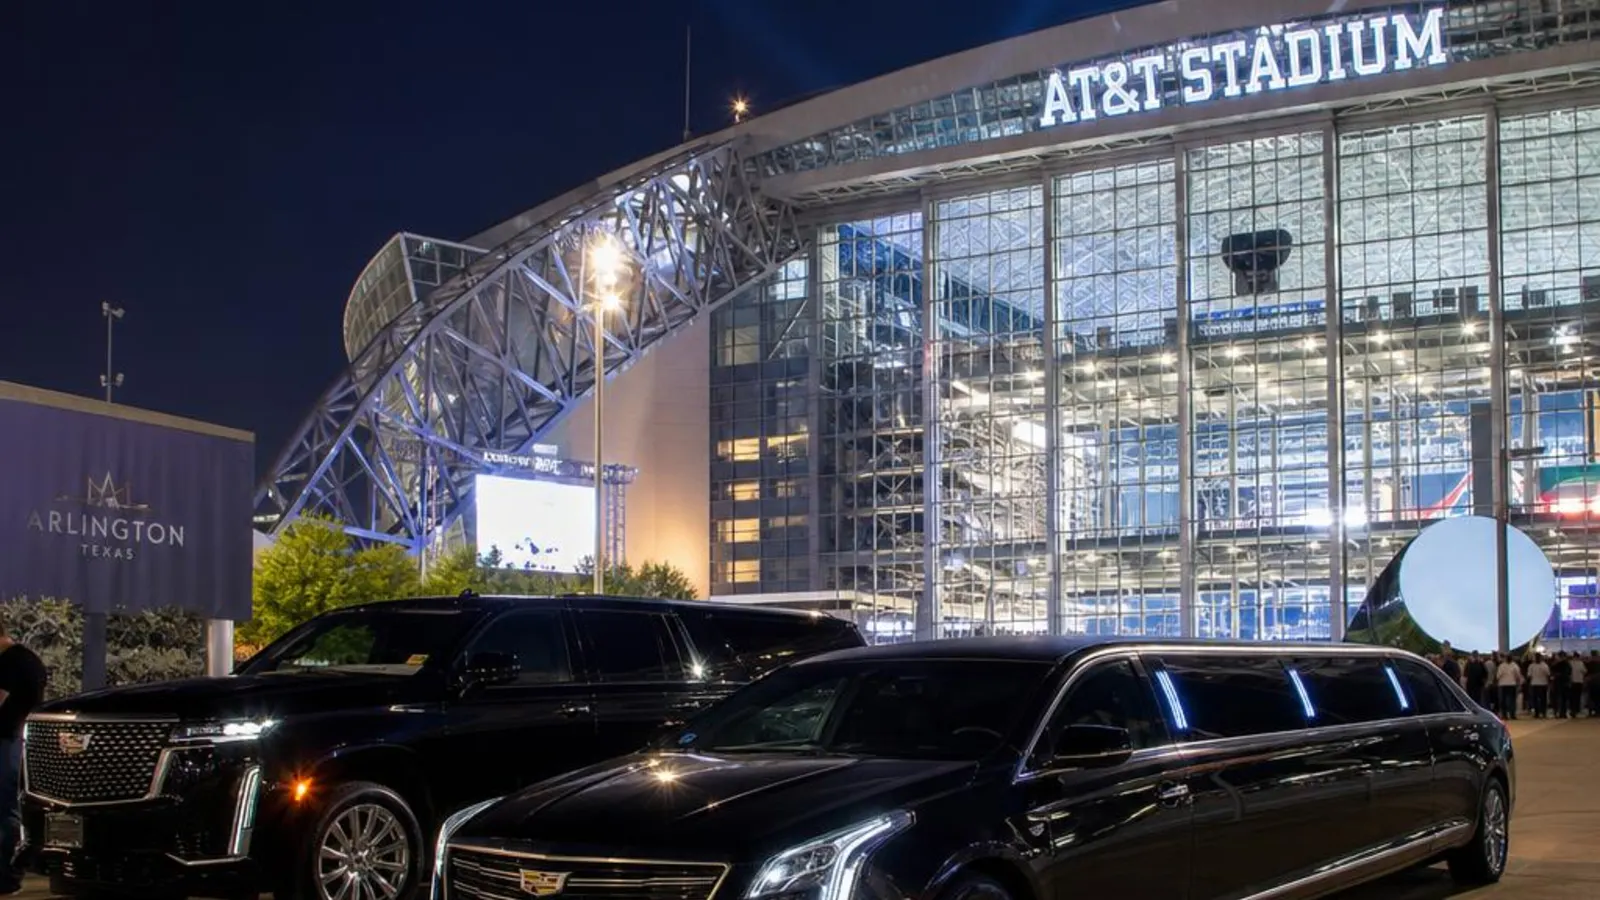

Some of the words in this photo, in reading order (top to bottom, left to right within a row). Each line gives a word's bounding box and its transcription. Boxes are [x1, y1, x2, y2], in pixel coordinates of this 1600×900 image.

[1040, 55, 1164, 127] AT&T
[1182, 8, 1447, 103] STADIUM
[28, 510, 184, 546] ARLINGTON
[82, 544, 134, 560] TEXAS
